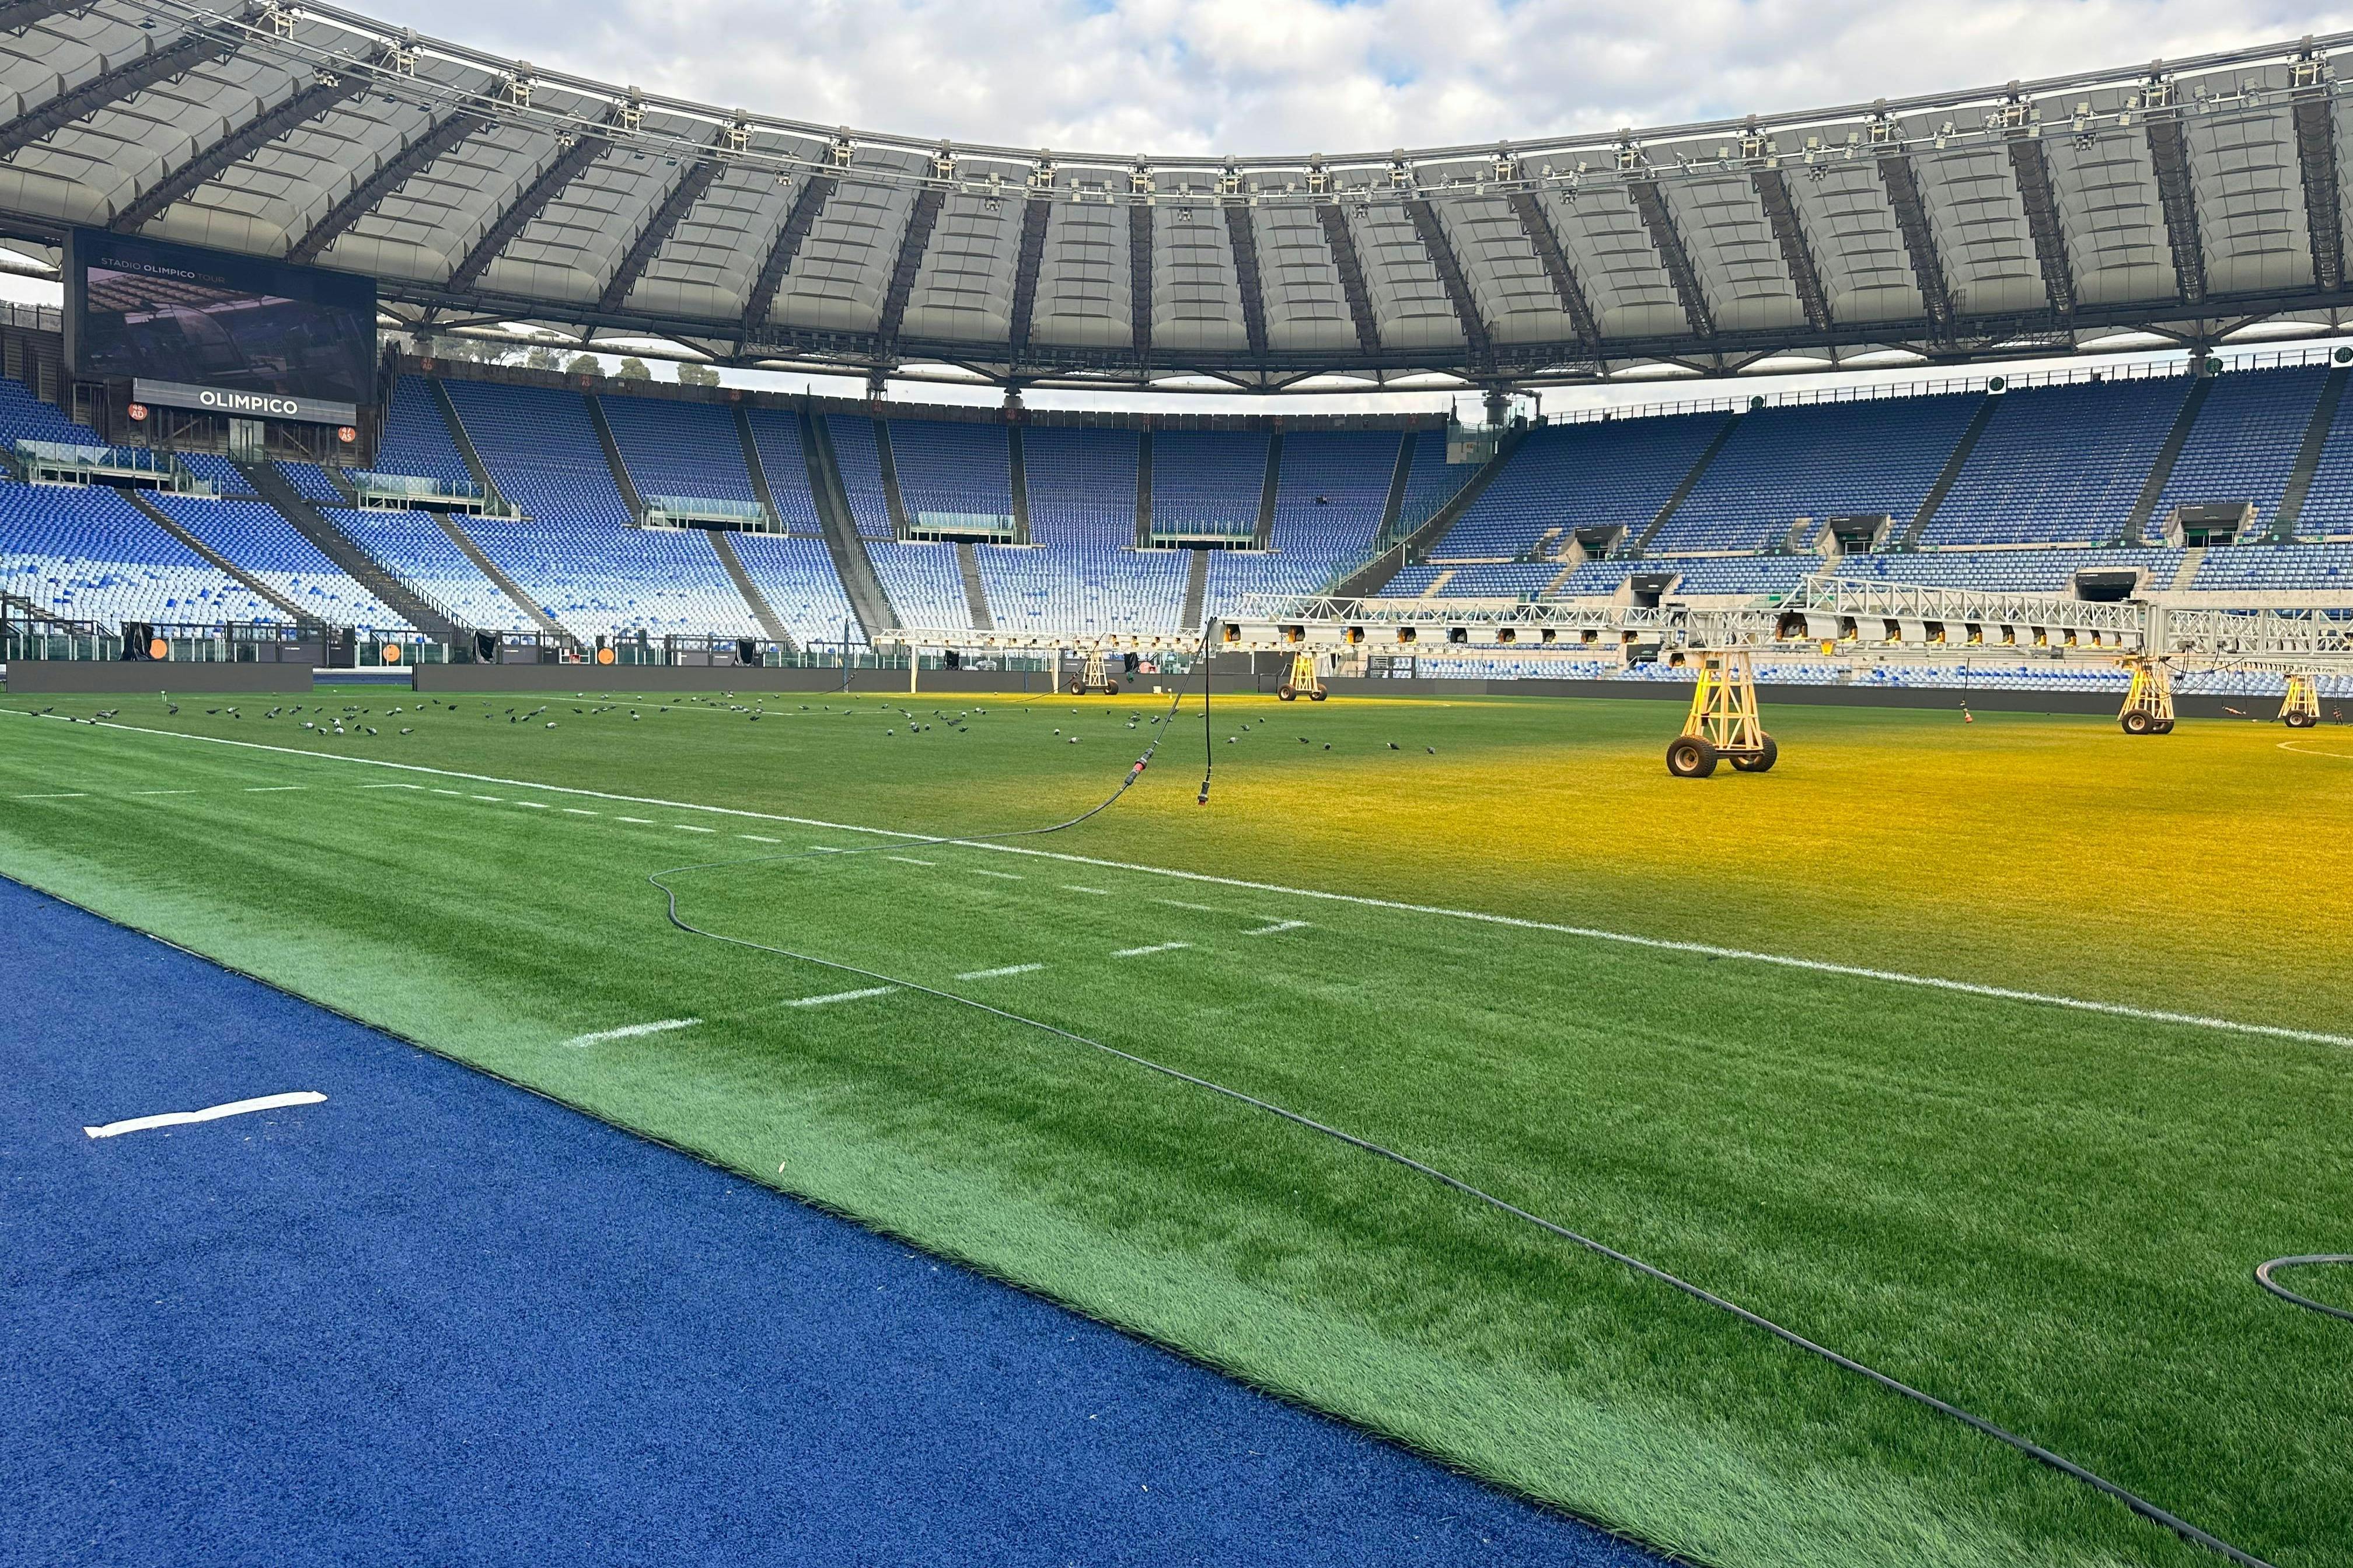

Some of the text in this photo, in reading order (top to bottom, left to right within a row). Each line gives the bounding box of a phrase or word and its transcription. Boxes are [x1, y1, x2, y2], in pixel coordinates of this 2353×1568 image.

[102, 257, 226, 284] STADIO OLIMPICO TOUR
[131, 410, 144, 418] AD
[200, 391, 298, 414] OLIMPICO
